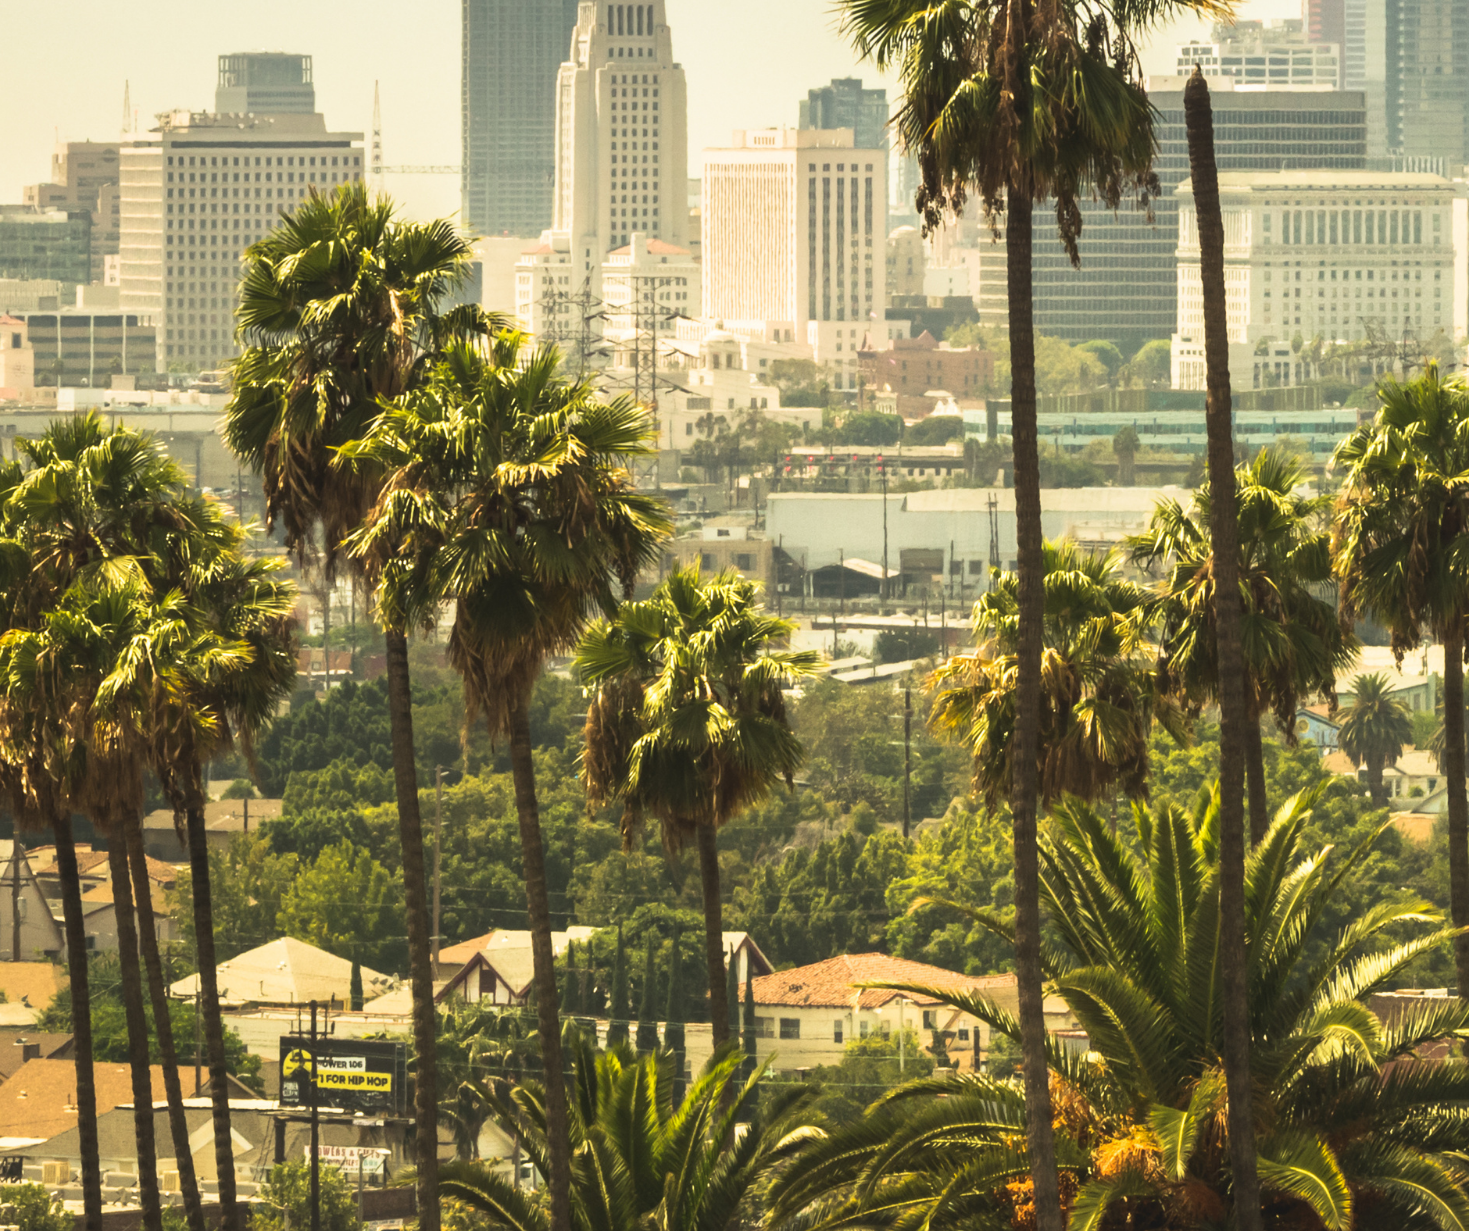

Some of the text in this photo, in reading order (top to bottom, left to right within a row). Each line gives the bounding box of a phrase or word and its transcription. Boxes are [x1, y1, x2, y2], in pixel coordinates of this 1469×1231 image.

[349, 1060, 363, 1069] 106
[326, 1074, 346, 1084] FOR
[348, 1075, 365, 1085] HIP
[367, 1076, 388, 1087] HOP
